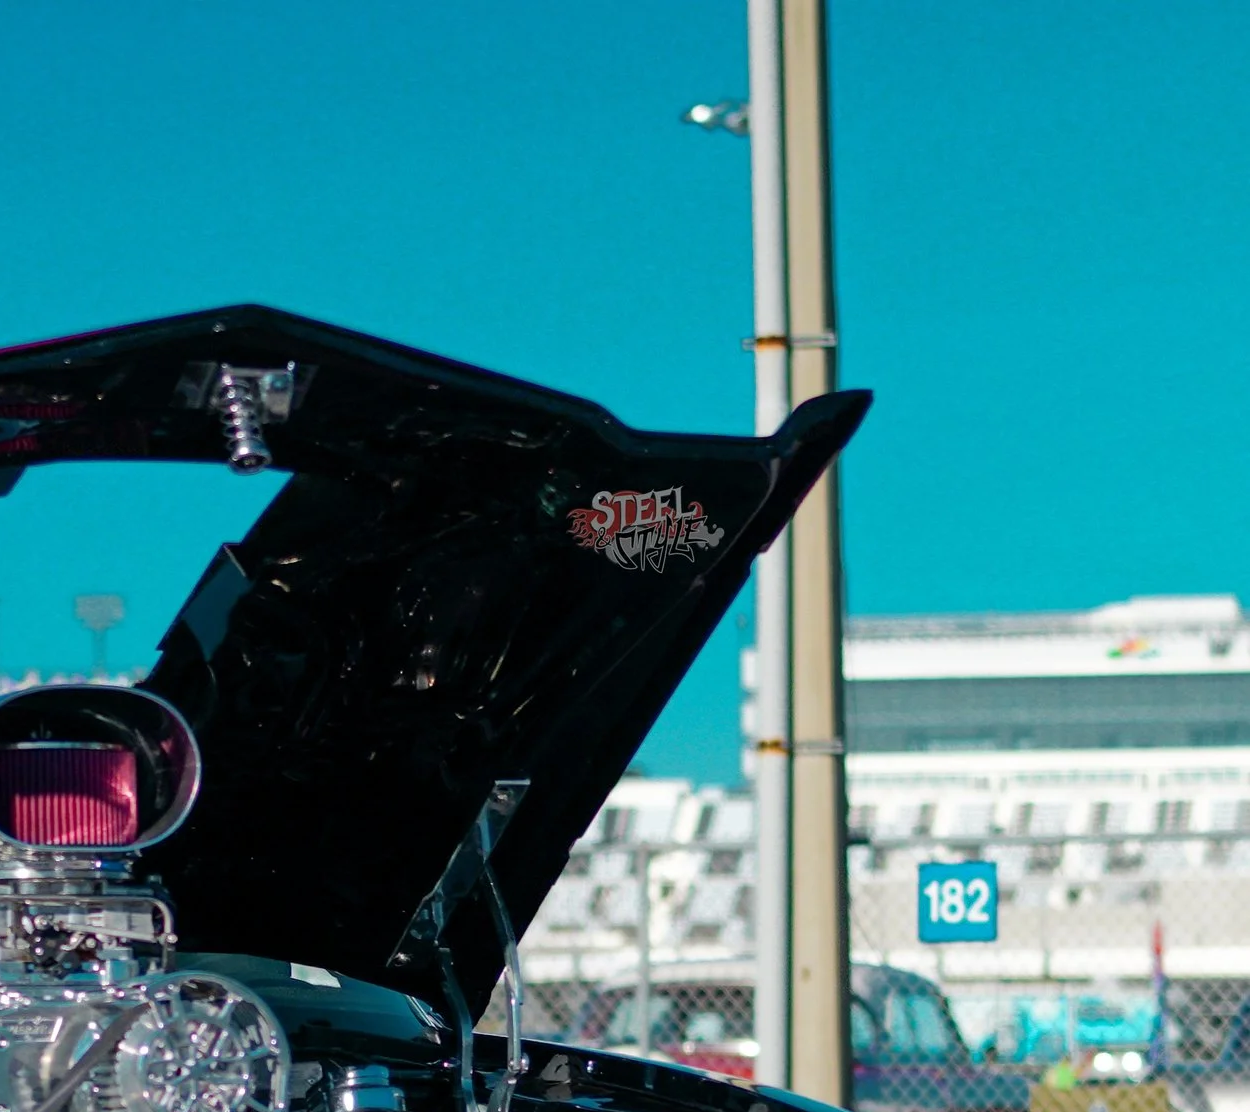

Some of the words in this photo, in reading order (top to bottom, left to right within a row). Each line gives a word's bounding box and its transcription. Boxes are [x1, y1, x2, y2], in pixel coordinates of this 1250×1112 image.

[589, 486, 698, 532] STEEL
[615, 515, 708, 573] STYLE
[924, 879, 989, 923] 182
